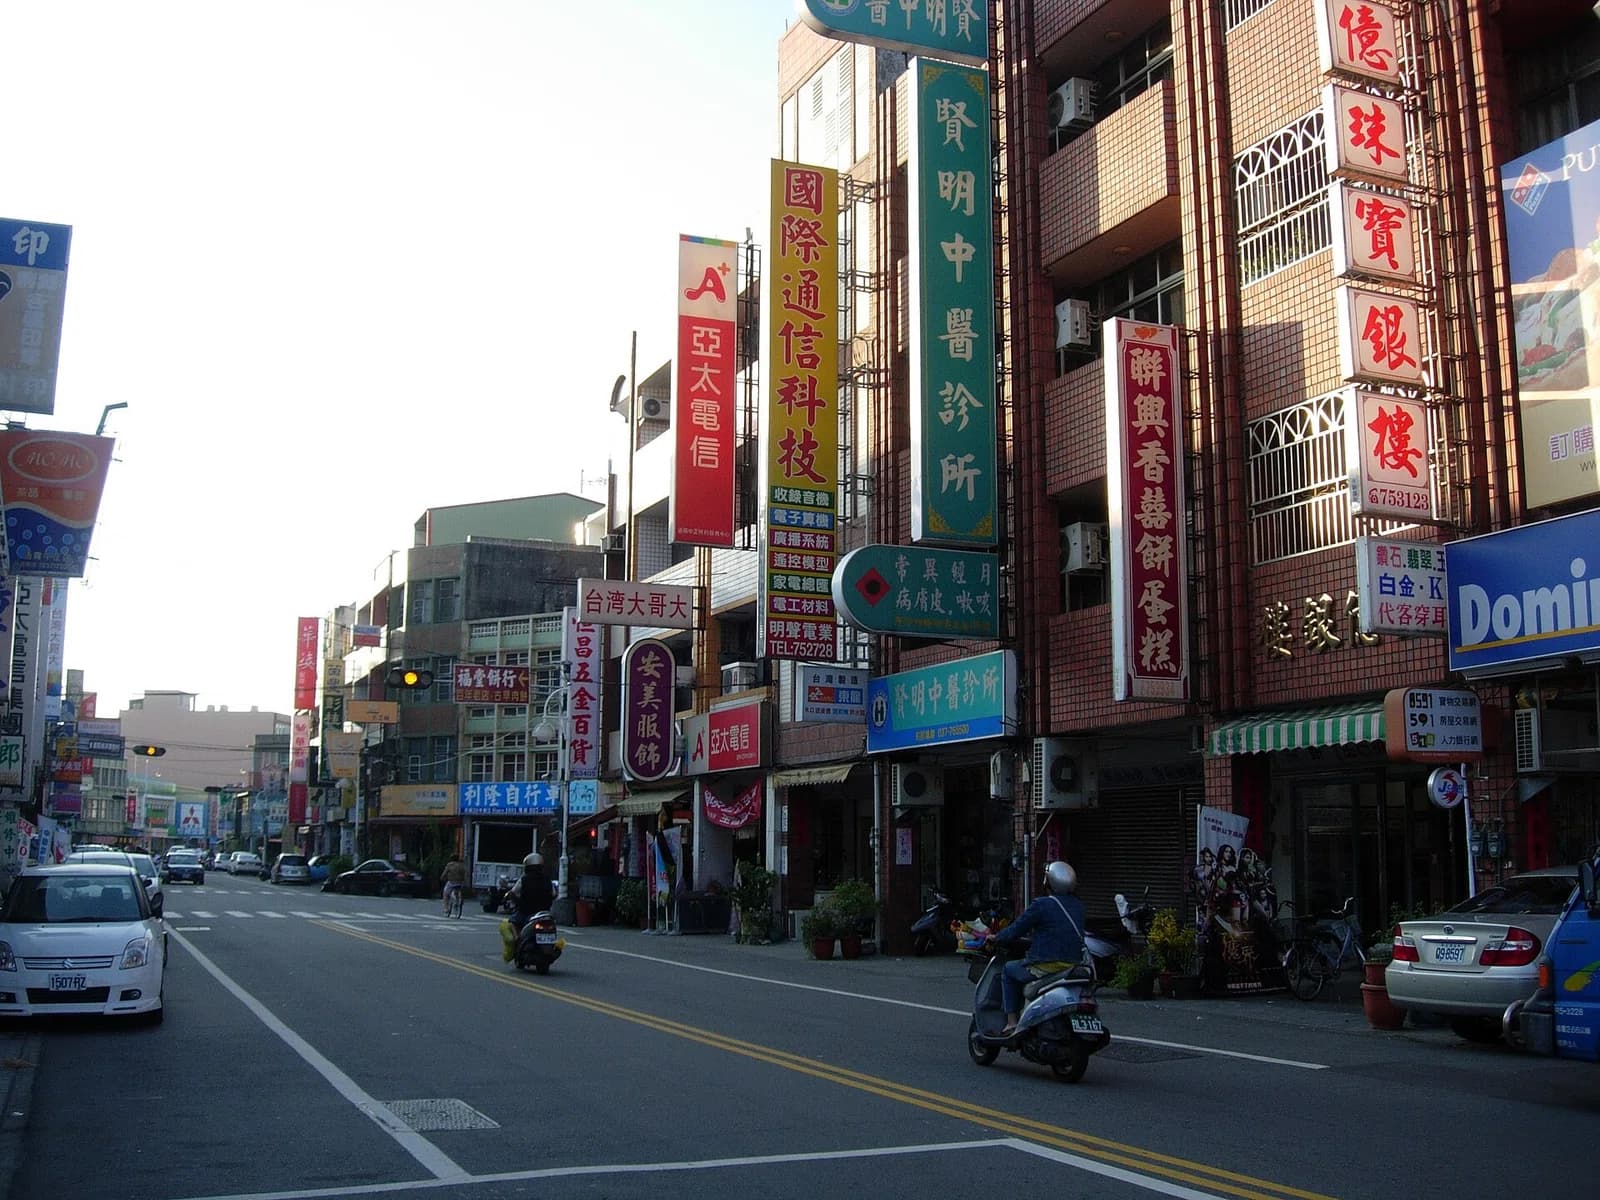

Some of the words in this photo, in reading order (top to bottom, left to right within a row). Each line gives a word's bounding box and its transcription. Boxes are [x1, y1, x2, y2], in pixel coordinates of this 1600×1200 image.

[936, 97, 984, 502] 賢明中醫診所
[776, 167, 829, 484] 國際通信科技
[689, 324, 722, 470] 亞太電信
[774, 488, 829, 507] 收錄音機
[1380, 489, 1429, 511] 753123
[774, 530, 829, 550] 廣播系統
[774, 553, 829, 572] 遙控模型
[774, 596, 829, 615] 電工材料
[634, 650, 665, 772] 安美服飾
[711, 725, 750, 755] 亞太電信
[464, 784, 560, 807] 利隆自行車
